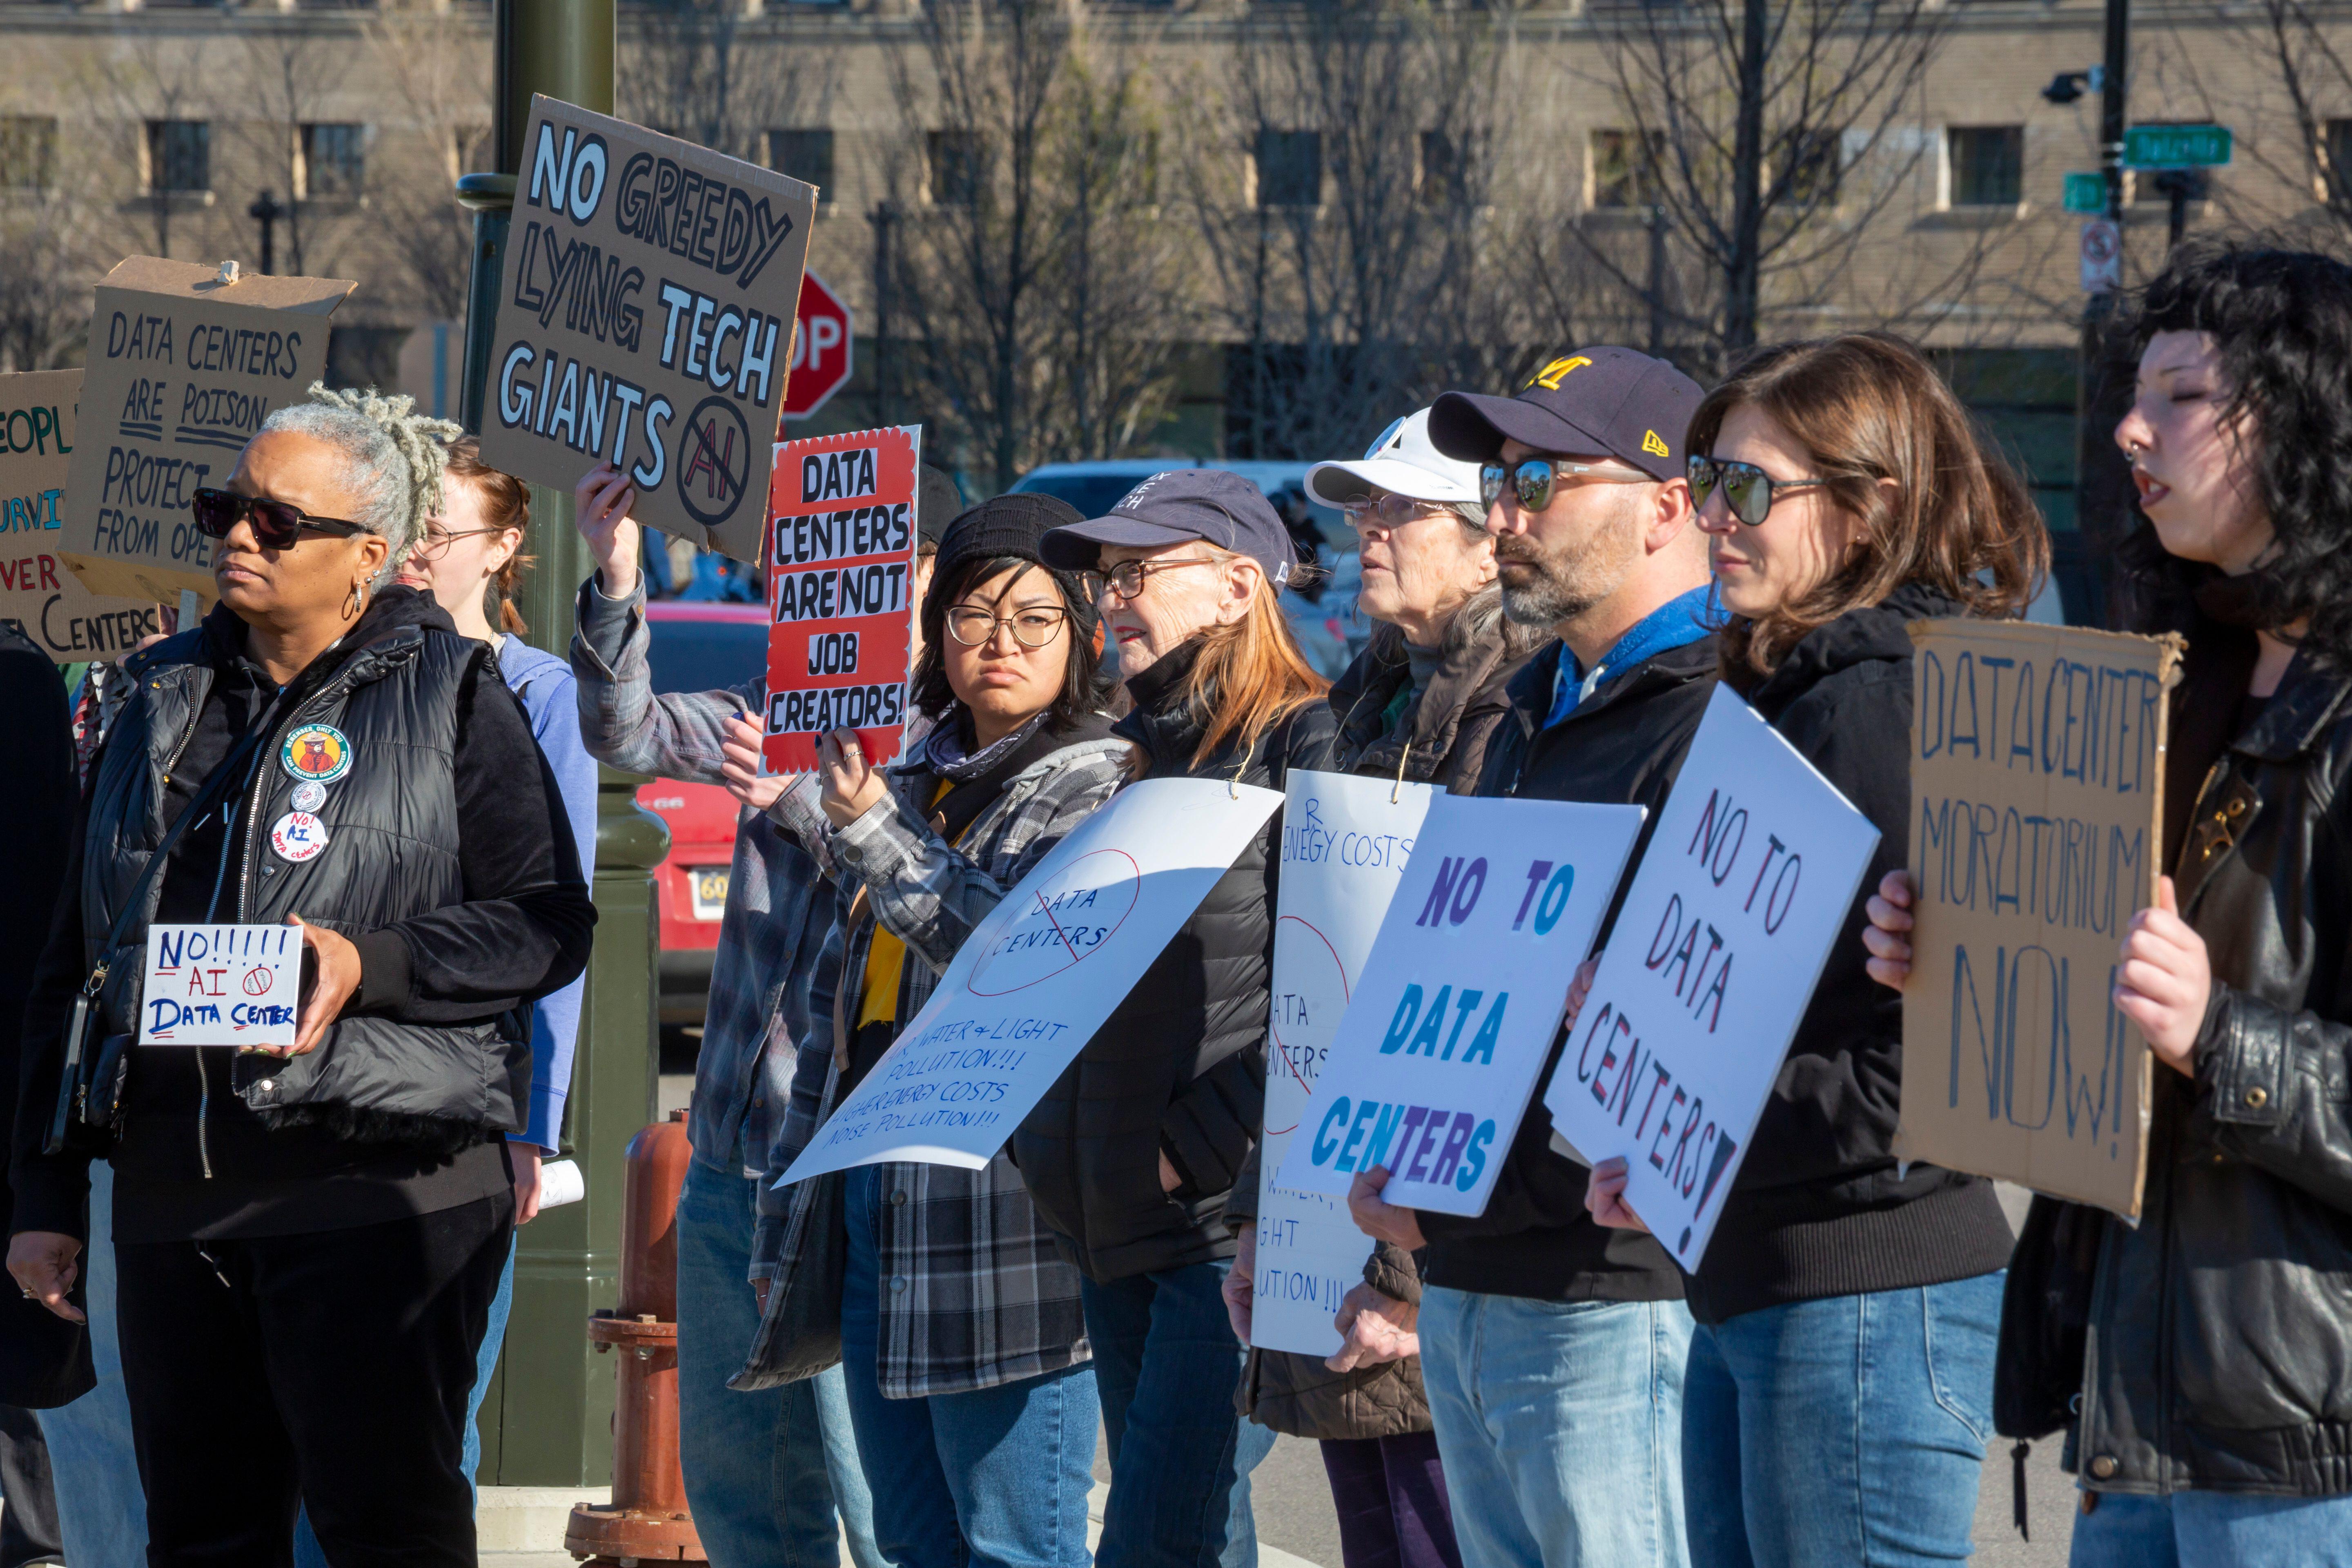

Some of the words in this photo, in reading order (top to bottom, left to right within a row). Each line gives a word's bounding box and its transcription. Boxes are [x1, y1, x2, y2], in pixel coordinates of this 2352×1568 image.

[528, 119, 608, 226] NO
[615, 151, 793, 289] GREEDY
[514, 222, 645, 352] LYING
[658, 278, 781, 408] TECH
[107, 311, 172, 365] DATA
[187, 324, 301, 379] CENTERS
[122, 379, 166, 422] ARE
[181, 383, 267, 433] POISON
[497, 341, 676, 492] GIANTS
[102, 446, 210, 510] PROTECT
[802, 448, 877, 503] DATA
[94, 509, 159, 558] FROM
[171, 522, 213, 568] OPE
[776, 502, 909, 566] CENTERS
[777, 572, 837, 623] ARE
[840, 564, 906, 616] NOT
[41, 593, 160, 652] CENTERS
[808, 633, 858, 675] JOB
[768, 683, 905, 734] CREATORS!
[332, 732, 343, 742] YOU
[286, 756, 295, 767] CAN
[292, 766, 317, 778] PREVENT
[332, 751, 347, 772] CENTERS
[272, 831, 287, 853] DATA
[287, 825, 310, 842] AI
[1342, 832, 1414, 873] COSTS
[1688, 788, 1748, 887] NO
[1744, 833, 1801, 935] TO
[1919, 797, 2143, 939] MORATORIUM
[1030, 889, 1098, 916] DATA
[1415, 856, 1488, 927] NO
[1512, 860, 1575, 936] TO
[159, 929, 287, 969] NO!!!!!
[992, 926, 1108, 956] CENTERS
[1646, 893, 1733, 1034] DATA
[189, 966, 227, 996] AI
[148, 998, 221, 1034] DATA
[918, 1020, 975, 1048] WATER
[990, 1018, 1068, 1041] LIGHT
[1270, 993, 1308, 1025] ATA
[1379, 983, 1509, 1065] DATA
[883, 1049, 1027, 1086] POLLUTION!!!
[1949, 944, 2120, 1161] NOW!
[940, 1081, 1009, 1102] COSTS
[823, 1123, 871, 1149] NOISE
[874, 1110, 1000, 1134] POLLUTION!!!
[1311, 1096, 1496, 1193] CENTERS
[1577, 1002, 1737, 1256] CENTERS!
